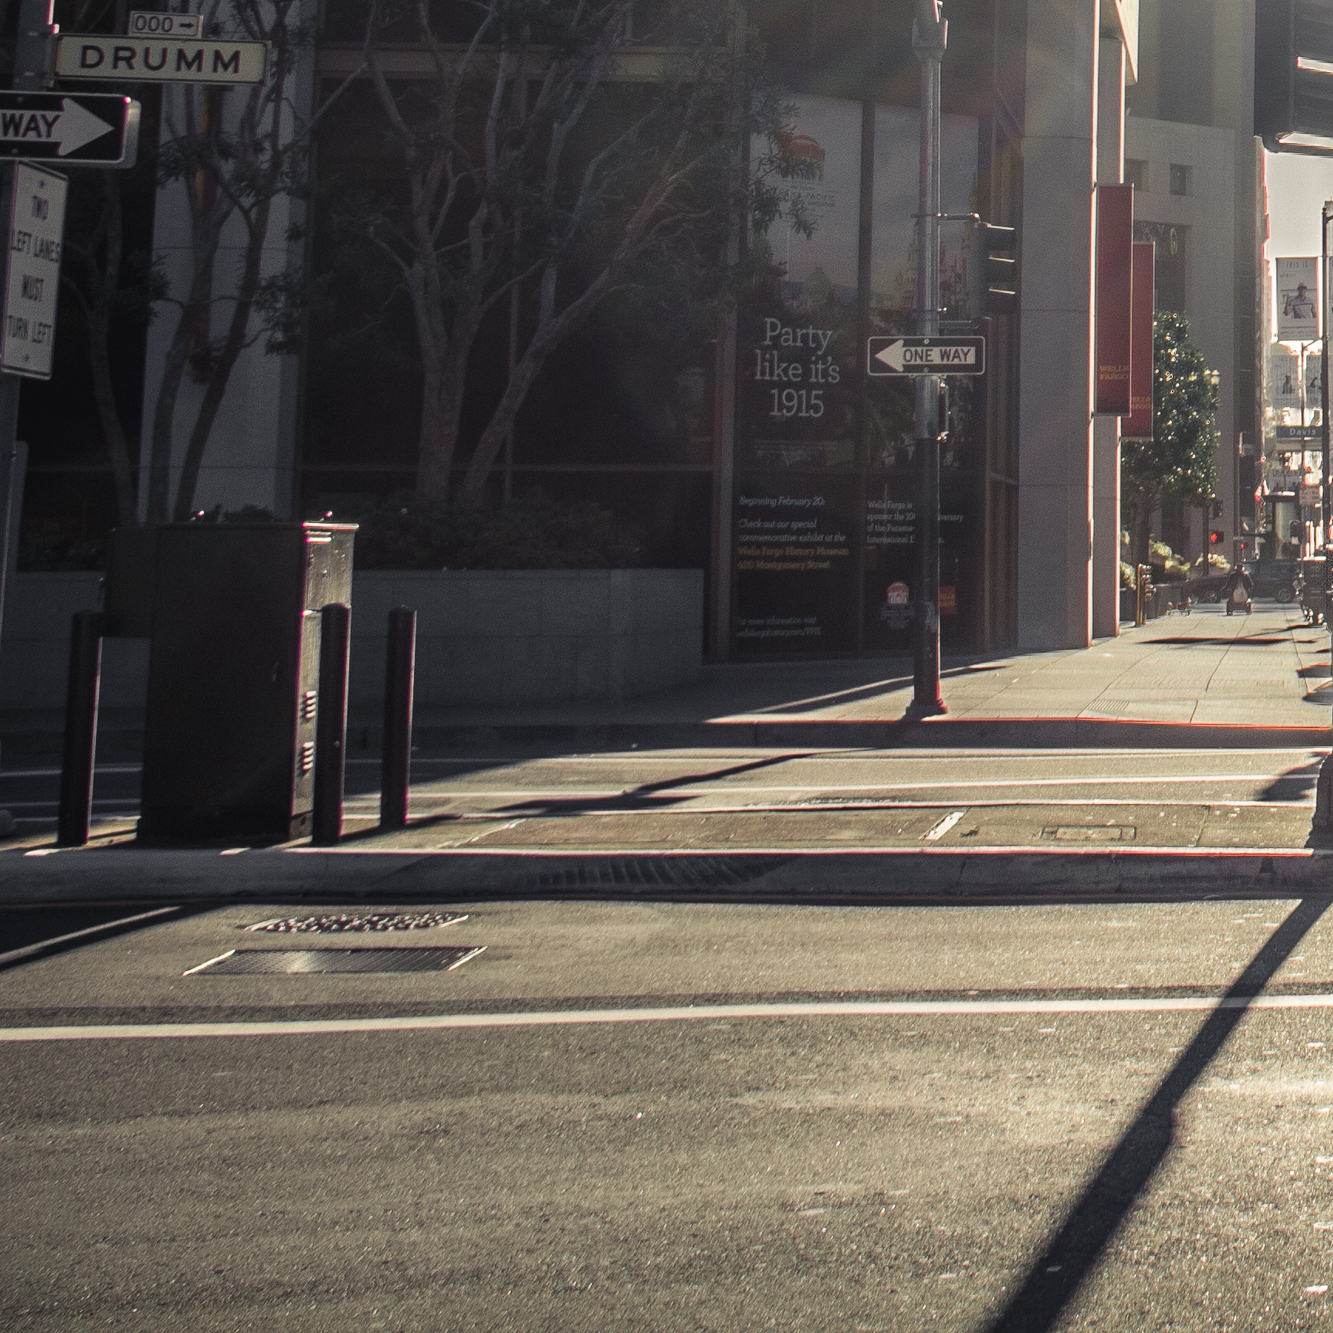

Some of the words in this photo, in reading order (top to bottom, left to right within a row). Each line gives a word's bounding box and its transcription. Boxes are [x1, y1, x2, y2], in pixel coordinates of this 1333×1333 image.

[80, 44, 241, 74] DRUMM
[1, 112, 62, 140] WAY
[31, 195, 49, 221] TWO
[10, 229, 32, 254] LEFT
[33, 236, 60, 263] LANES
[21, 274, 45, 302] MUST
[6, 315, 29, 340] TURN
[31, 321, 52, 345] LEFT
[764, 317, 833, 355] Party
[903, 348, 934, 363] ONE
[939, 348, 972, 362] WAY
[755, 349, 803, 382] like
[809, 356, 840, 383] it's
[1099, 373, 1128, 381] FARGO
[769, 388, 824, 418] 1915
[1289, 428, 1316, 436] Davis
[739, 495, 776, 508] Beginning
[778, 495, 811, 508] February
[868, 501, 887, 509] Wells
[887, 501, 905, 510] Fargo
[738, 518, 762, 528] Check
[763, 519, 775, 528] out
[790, 518, 817, 531] special
[894, 512, 905, 521] the
[799, 532, 824, 542] exhibit
[825, 534, 833, 542] at
[834, 532, 846, 542] the
[756, 560, 806, 571] Montgomery
